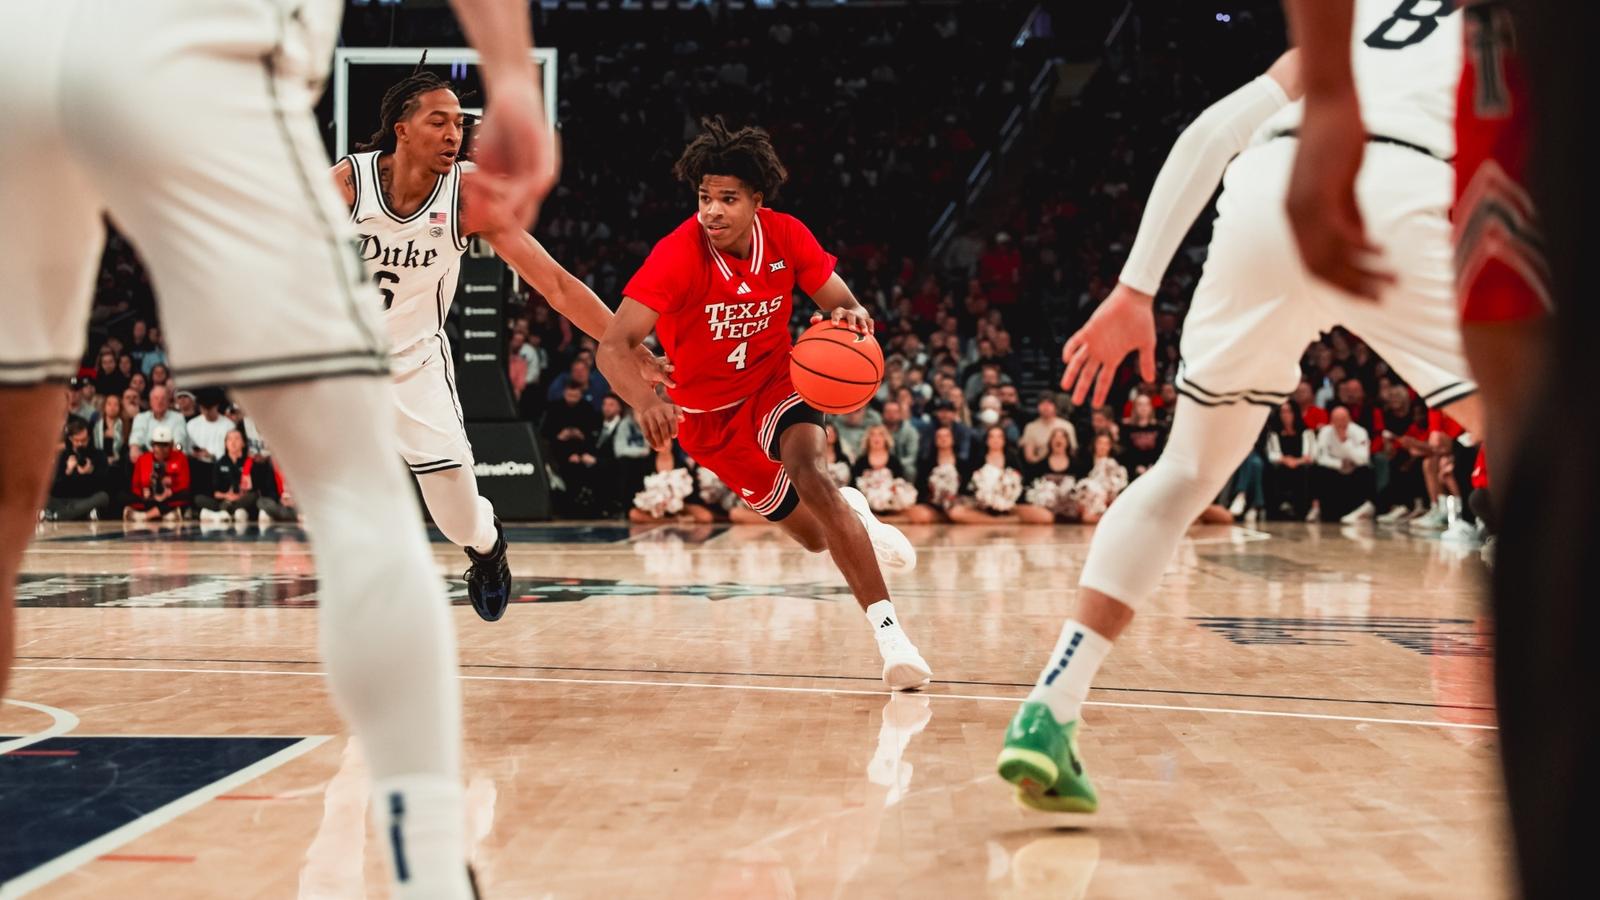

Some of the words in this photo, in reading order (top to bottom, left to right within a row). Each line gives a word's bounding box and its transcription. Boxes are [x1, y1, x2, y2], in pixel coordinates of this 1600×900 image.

[357, 233, 438, 268] Duke
[704, 295, 784, 324] TEXAS
[710, 316, 772, 341] TECH
[726, 341, 748, 371] 4
